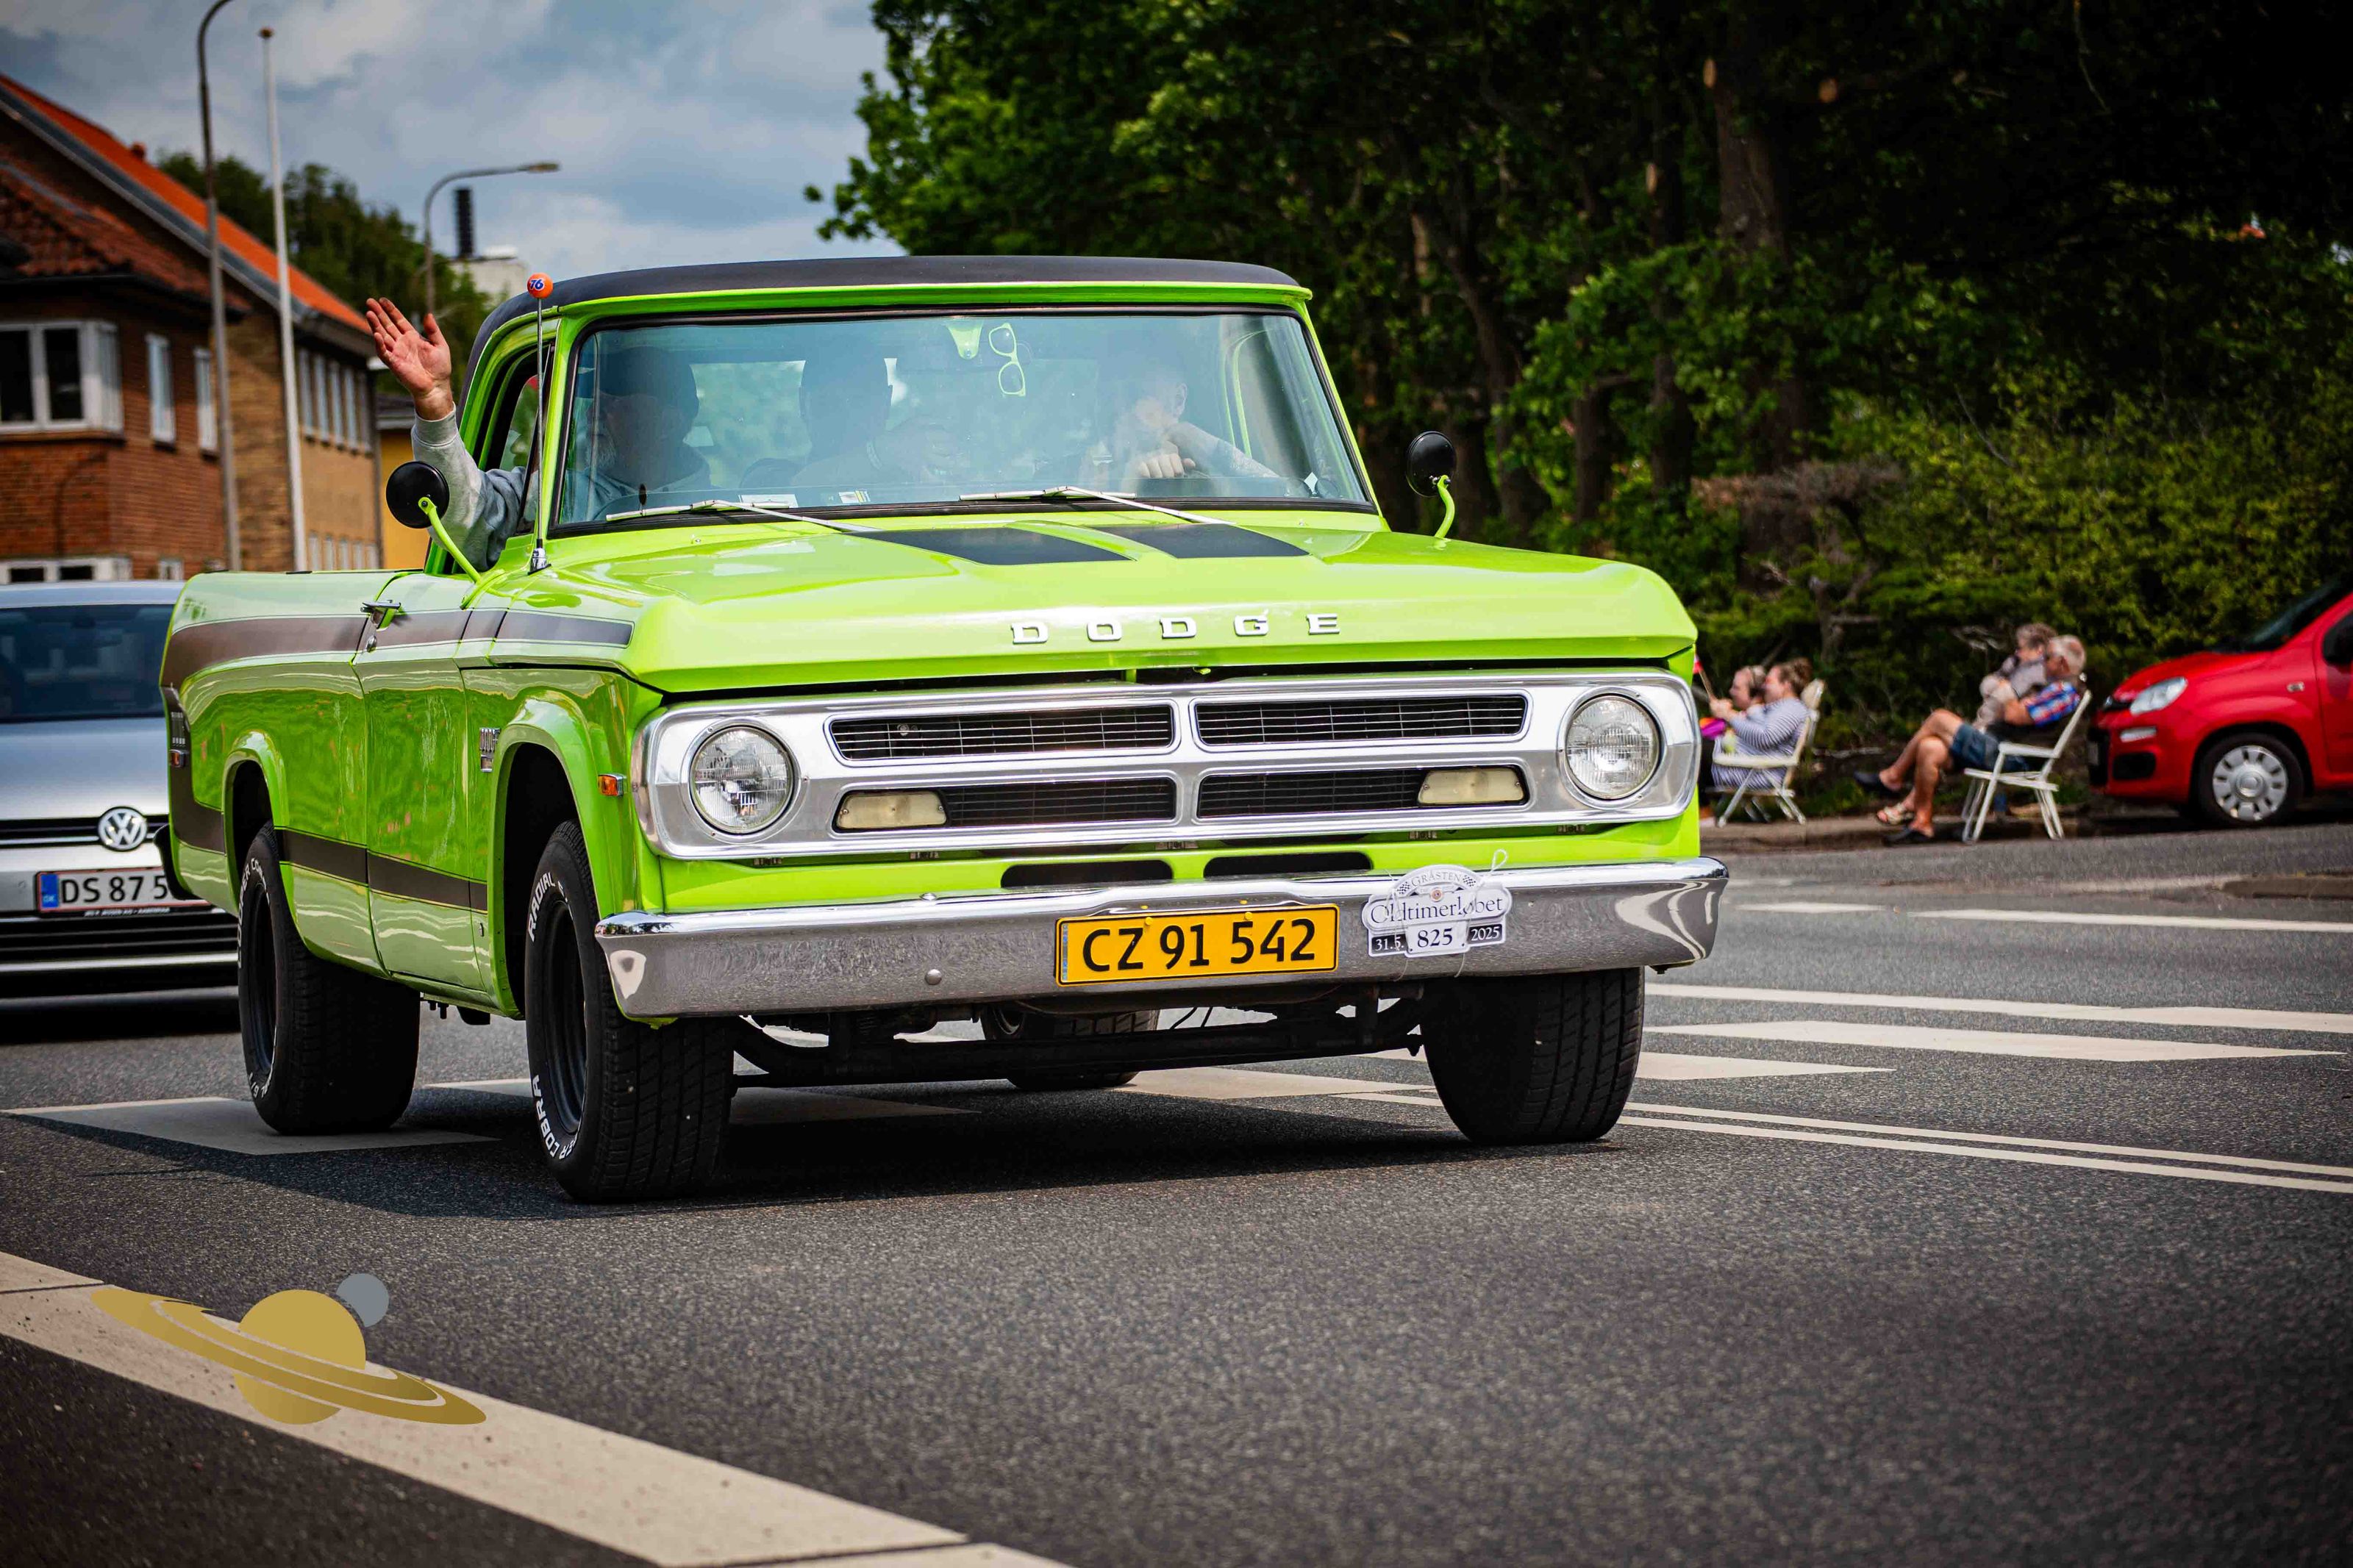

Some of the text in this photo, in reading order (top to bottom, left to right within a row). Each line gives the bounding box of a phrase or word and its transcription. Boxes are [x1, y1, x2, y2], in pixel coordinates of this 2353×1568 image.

[530, 278, 545, 290] 76
[1011, 613, 1340, 644] DODGE
[61, 877, 101, 903] DS
[109, 876, 144, 902] 87
[1411, 869, 1462, 887] GRÅSTEN
[528, 872, 556, 942] RADIAL
[1082, 918, 1315, 973] CZ 91 542
[1417, 928, 1453, 948] 825
[1471, 926, 1500, 942] 2025
[532, 1075, 560, 1157] COBRA
